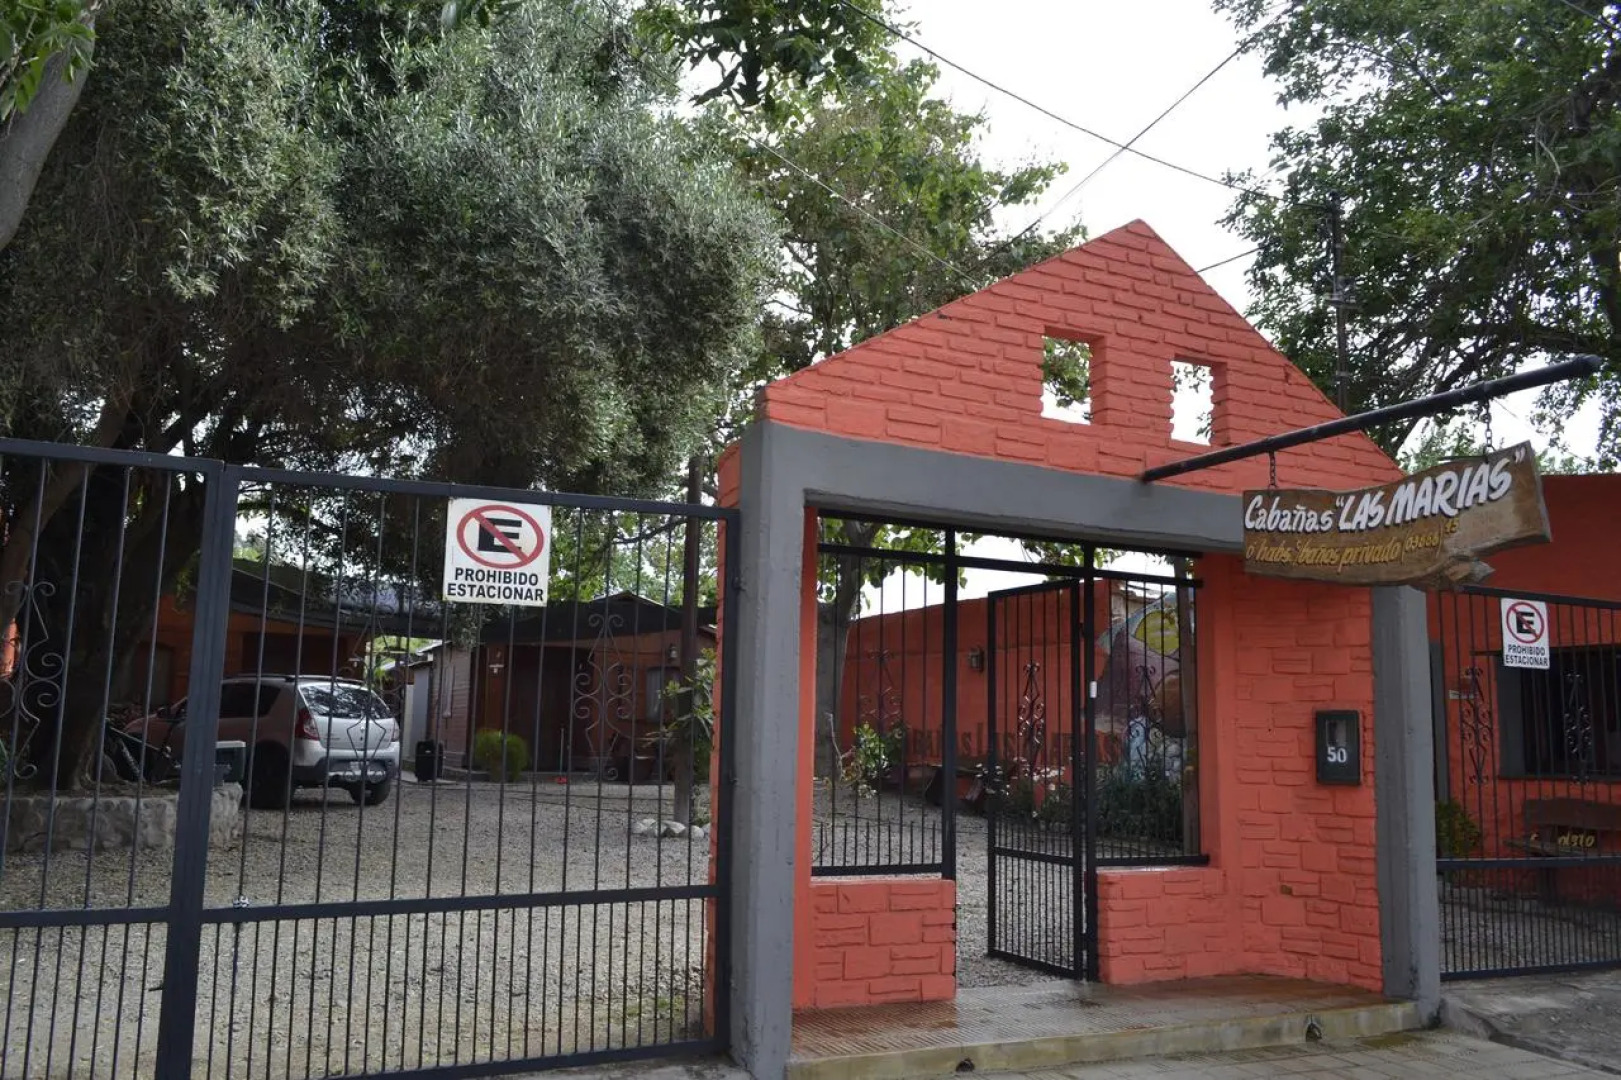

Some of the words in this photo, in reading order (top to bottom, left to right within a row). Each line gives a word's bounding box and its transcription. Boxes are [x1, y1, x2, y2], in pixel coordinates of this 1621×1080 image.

[1245, 494, 1334, 533] Cabañas
[1337, 537, 1401, 573] privado
[455, 568, 538, 586] PROHIBIDO
[447, 583, 544, 602] ESTACIONAR
[1508, 644, 1546, 655] PROHIBIDO
[1505, 655, 1549, 667] ESTACIONAR
[1327, 746, 1347, 763] 50
